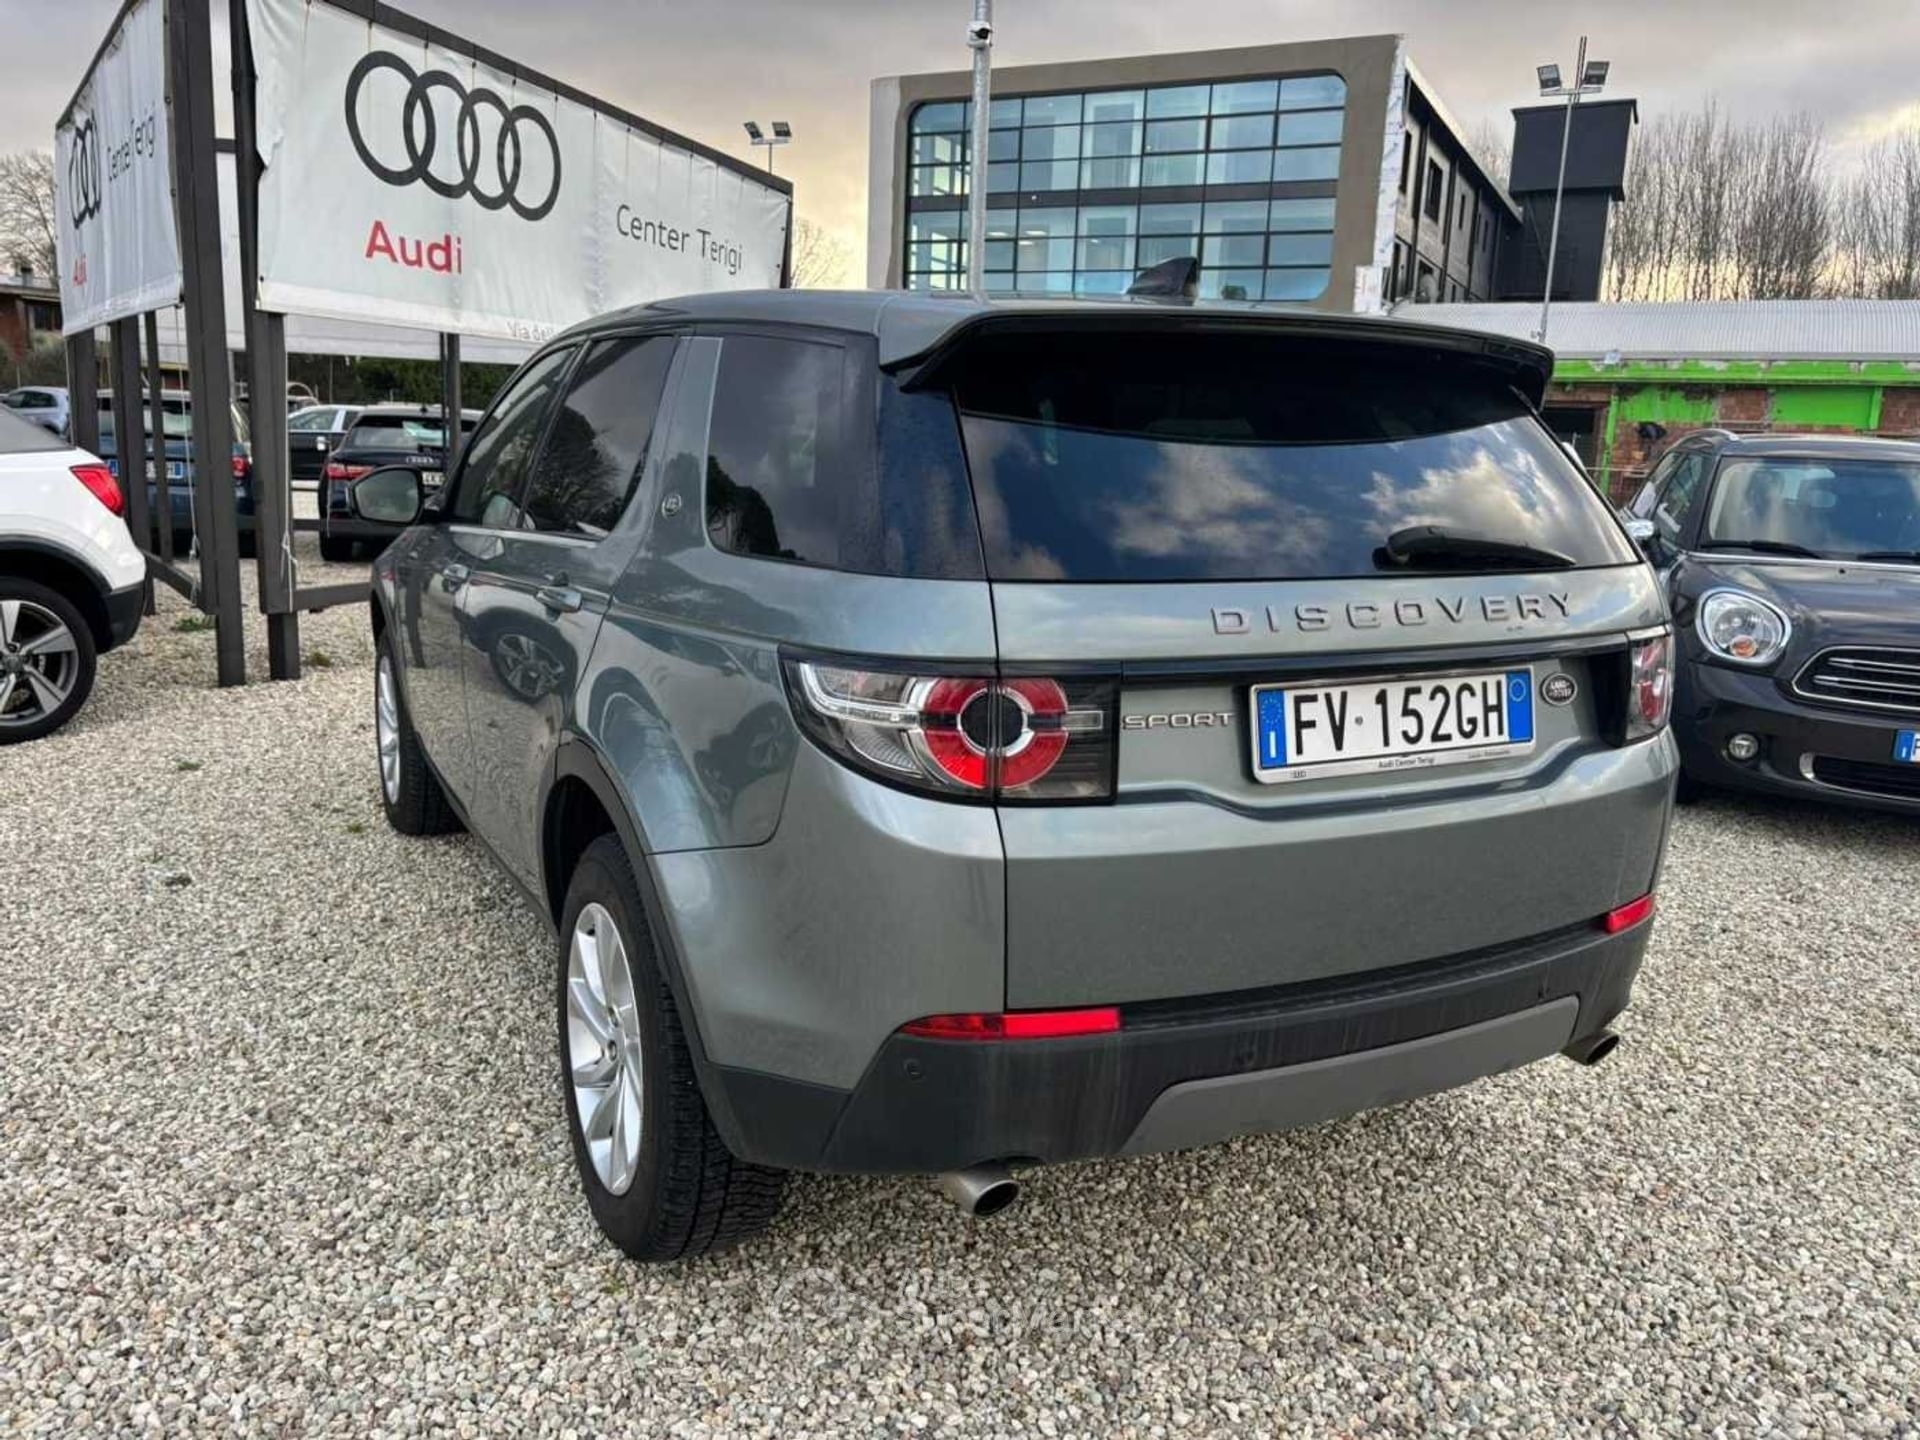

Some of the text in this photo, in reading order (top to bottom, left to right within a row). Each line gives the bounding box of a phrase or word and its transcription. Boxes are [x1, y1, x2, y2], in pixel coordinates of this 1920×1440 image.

[365, 219, 462, 274] Audi
[616, 204, 742, 275] Center Terigi
[1210, 592, 1572, 634] DISCOVERY
[1121, 711, 1233, 730] SPORT
[1293, 690, 1349, 756] FV
[1374, 680, 1504, 748] 152GH
